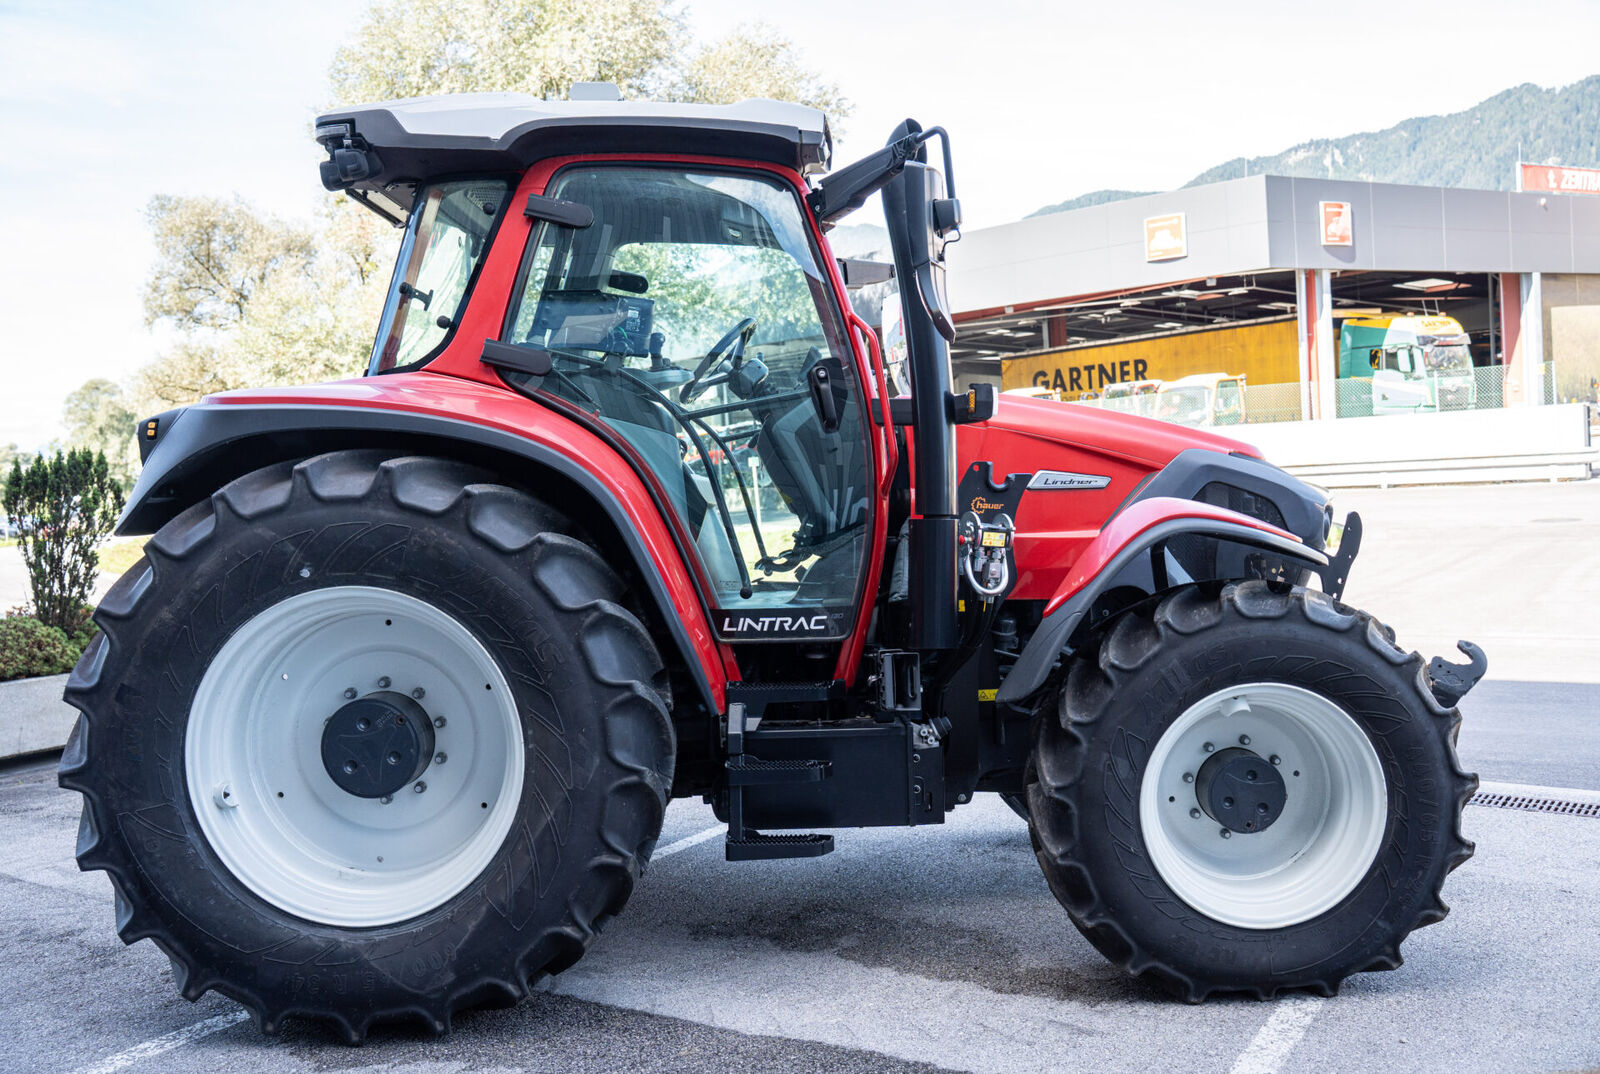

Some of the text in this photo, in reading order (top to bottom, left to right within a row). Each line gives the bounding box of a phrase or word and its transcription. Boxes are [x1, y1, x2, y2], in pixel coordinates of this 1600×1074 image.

[1033, 359, 1148, 392] GARTNER
[1043, 477, 1098, 486] Lindner
[976, 501, 1004, 509] hauer
[722, 616, 828, 632] LINTRAC
